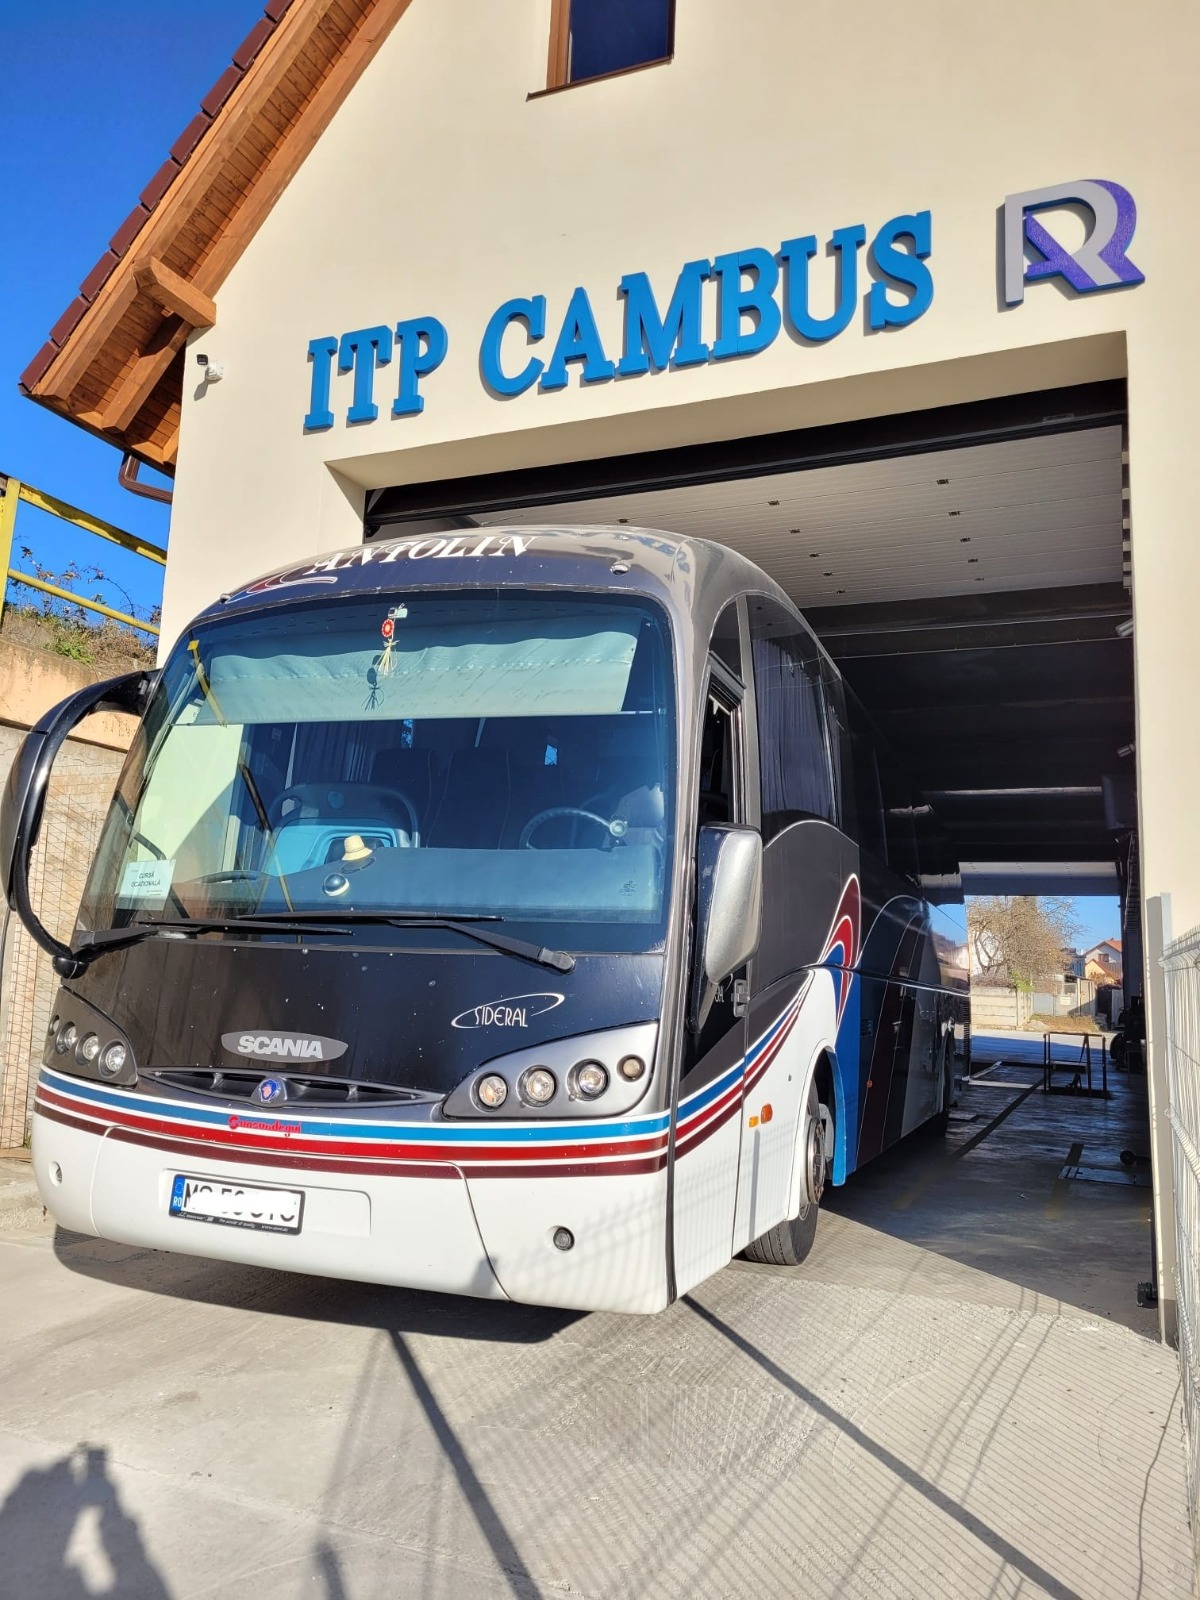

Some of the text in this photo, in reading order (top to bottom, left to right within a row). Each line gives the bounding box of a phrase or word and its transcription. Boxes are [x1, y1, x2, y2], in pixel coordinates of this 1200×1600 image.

[304, 315, 448, 431] ITP
[479, 210, 933, 398] CAMBUS
[302, 535, 539, 576] ANTOLIN
[474, 1005, 529, 1028] SIDERAL
[237, 1035, 323, 1059] SCANIA
[172, 1196, 183, 1207] RO
